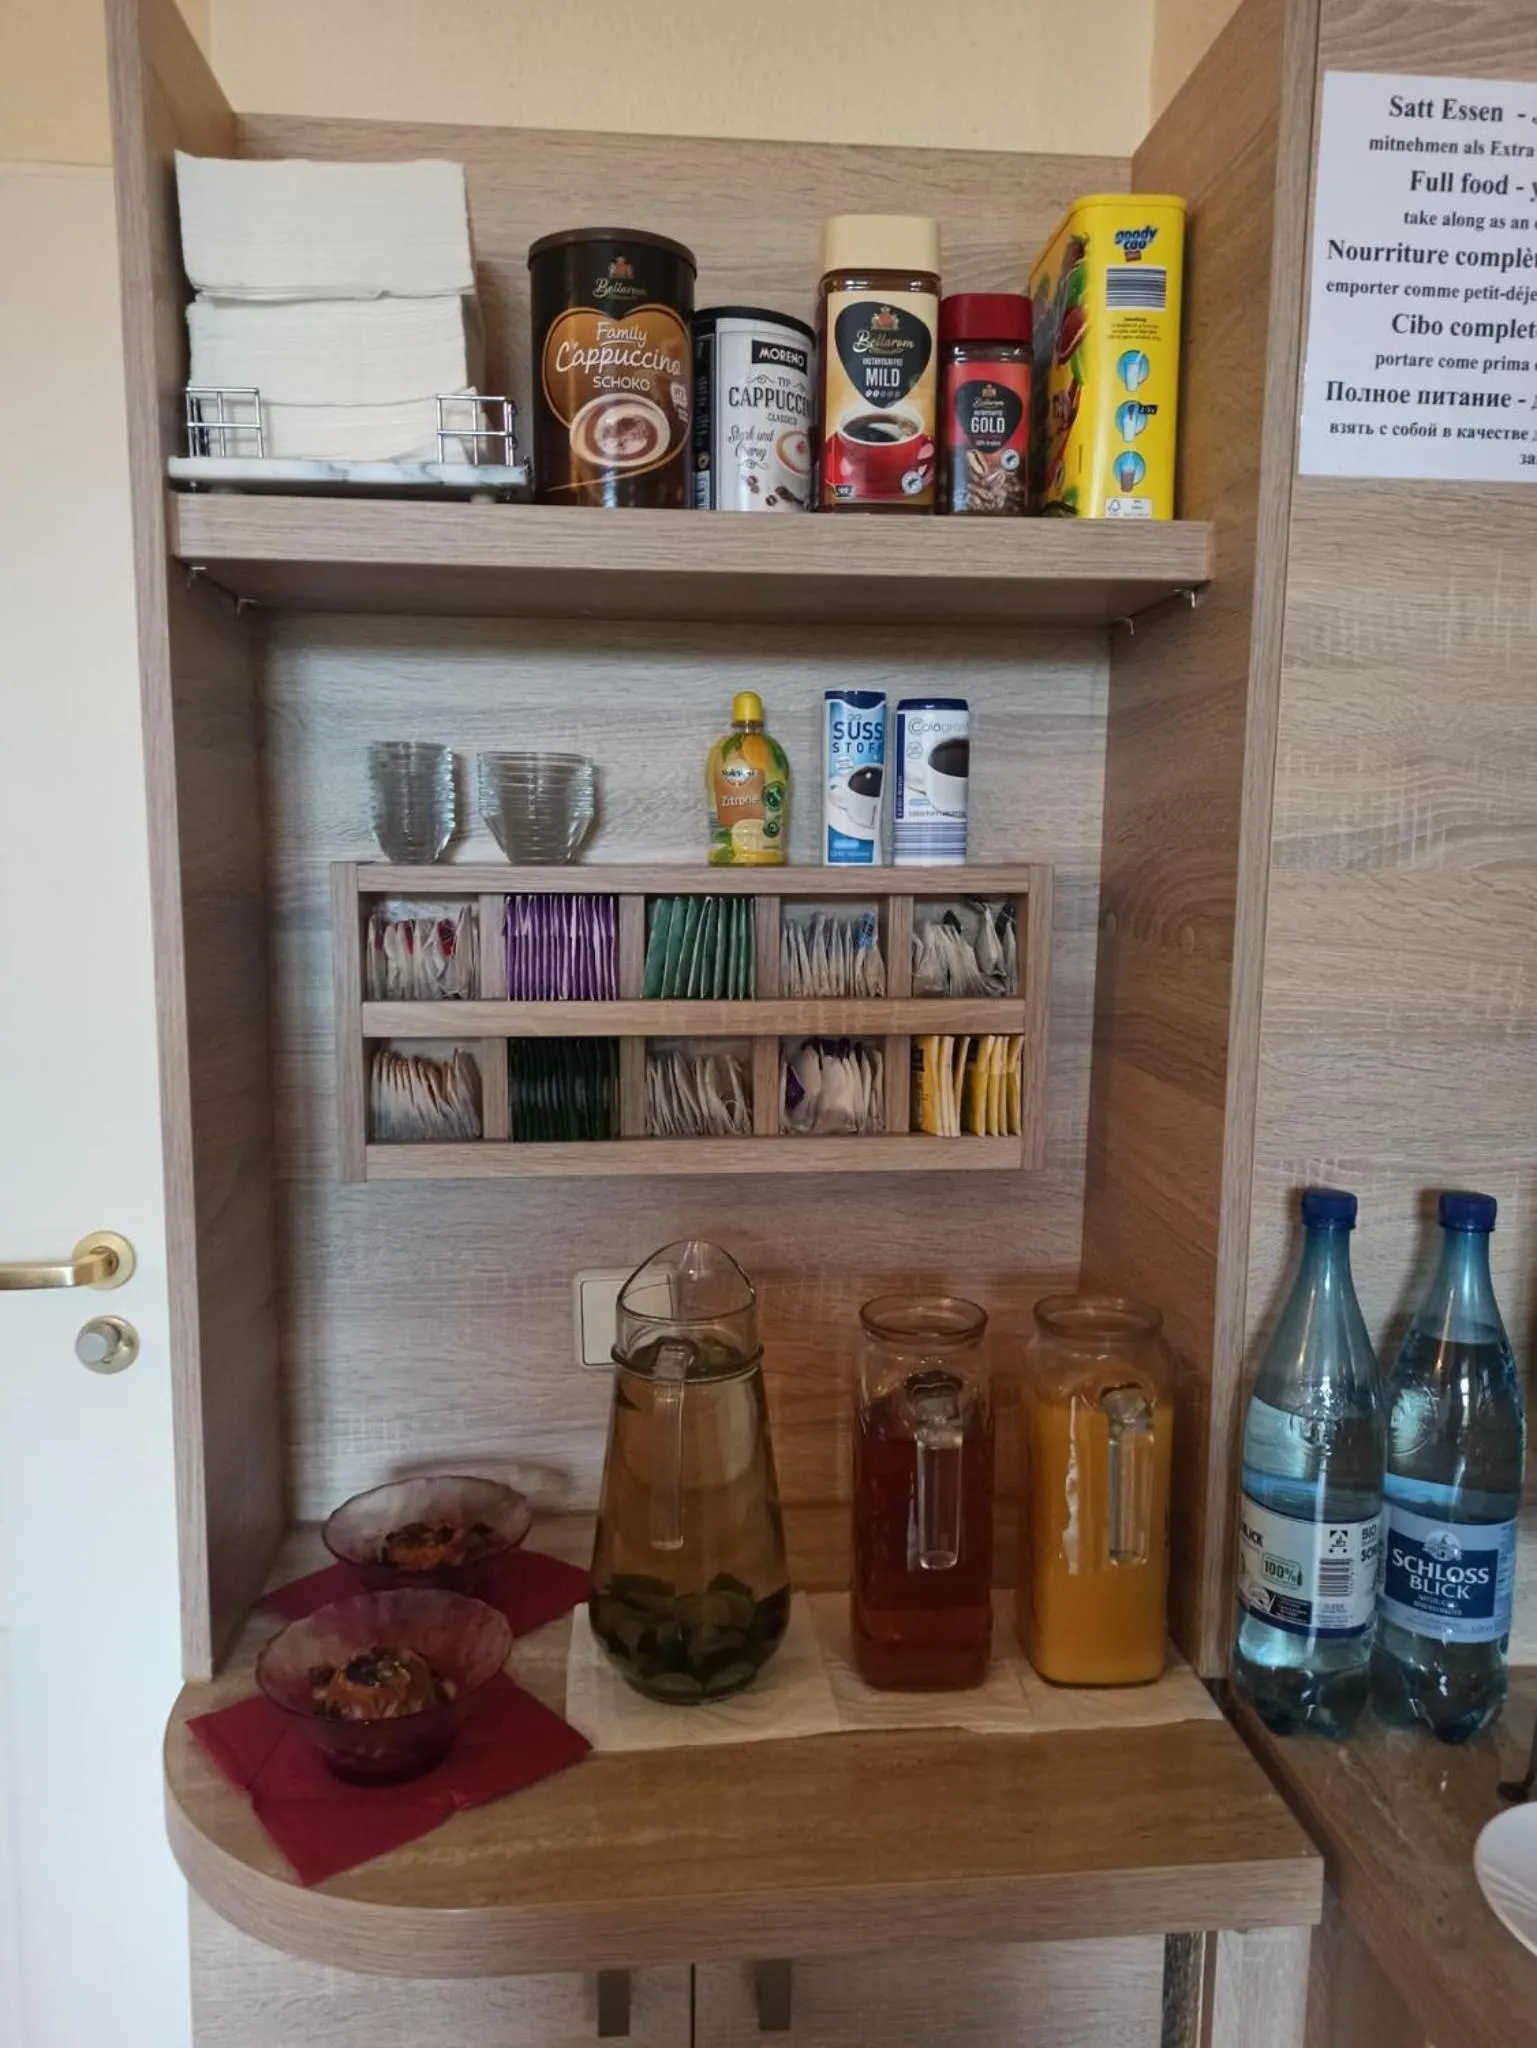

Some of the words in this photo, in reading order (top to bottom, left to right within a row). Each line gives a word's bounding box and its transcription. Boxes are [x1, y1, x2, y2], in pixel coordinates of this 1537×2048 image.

[1389, 95, 1434, 119] Satt
[1441, 98, 1504, 123] Essen
[1369, 135, 1459, 154] mitnehmen
[1463, 139, 1485, 155] als
[1490, 140, 1535, 158] Extra
[1410, 170, 1454, 193] Full
[1461, 172, 1509, 196] food
[1403, 210, 1438, 226] take
[1441, 211, 1485, 232] along
[1489, 217, 1506, 229] as
[1510, 218, 1530, 231] an
[1115, 224, 1158, 245] goody
[1328, 239, 1449, 265] Nourriture
[1325, 281, 1400, 298] emporter
[1403, 285, 1460, 299] comme
[596, 321, 648, 347] Family
[1391, 313, 1444, 336] Cibo
[556, 341, 682, 376] Cappuccino
[759, 347, 806, 367] MORENO
[1375, 353, 1434, 370] portare
[1437, 356, 1479, 370] come
[1482, 355, 1530, 375] prima
[593, 376, 651, 391] SCHOKO
[866, 367, 900, 387] MILD
[1326, 380, 1411, 404] Полное
[1417, 390, 1512, 408] питание
[971, 416, 1005, 434] GOLD
[1329, 422, 1375, 435] взять
[1379, 424, 1388, 436] с
[1391, 421, 1438, 438] собой
[1442, 427, 1452, 438] в
[1456, 427, 1529, 441] качестве
[1264, 1560, 1297, 1583] 100%
[1391, 1547, 1490, 1584] SCHLOSS
[1409, 1574, 1471, 1601] BLICK
